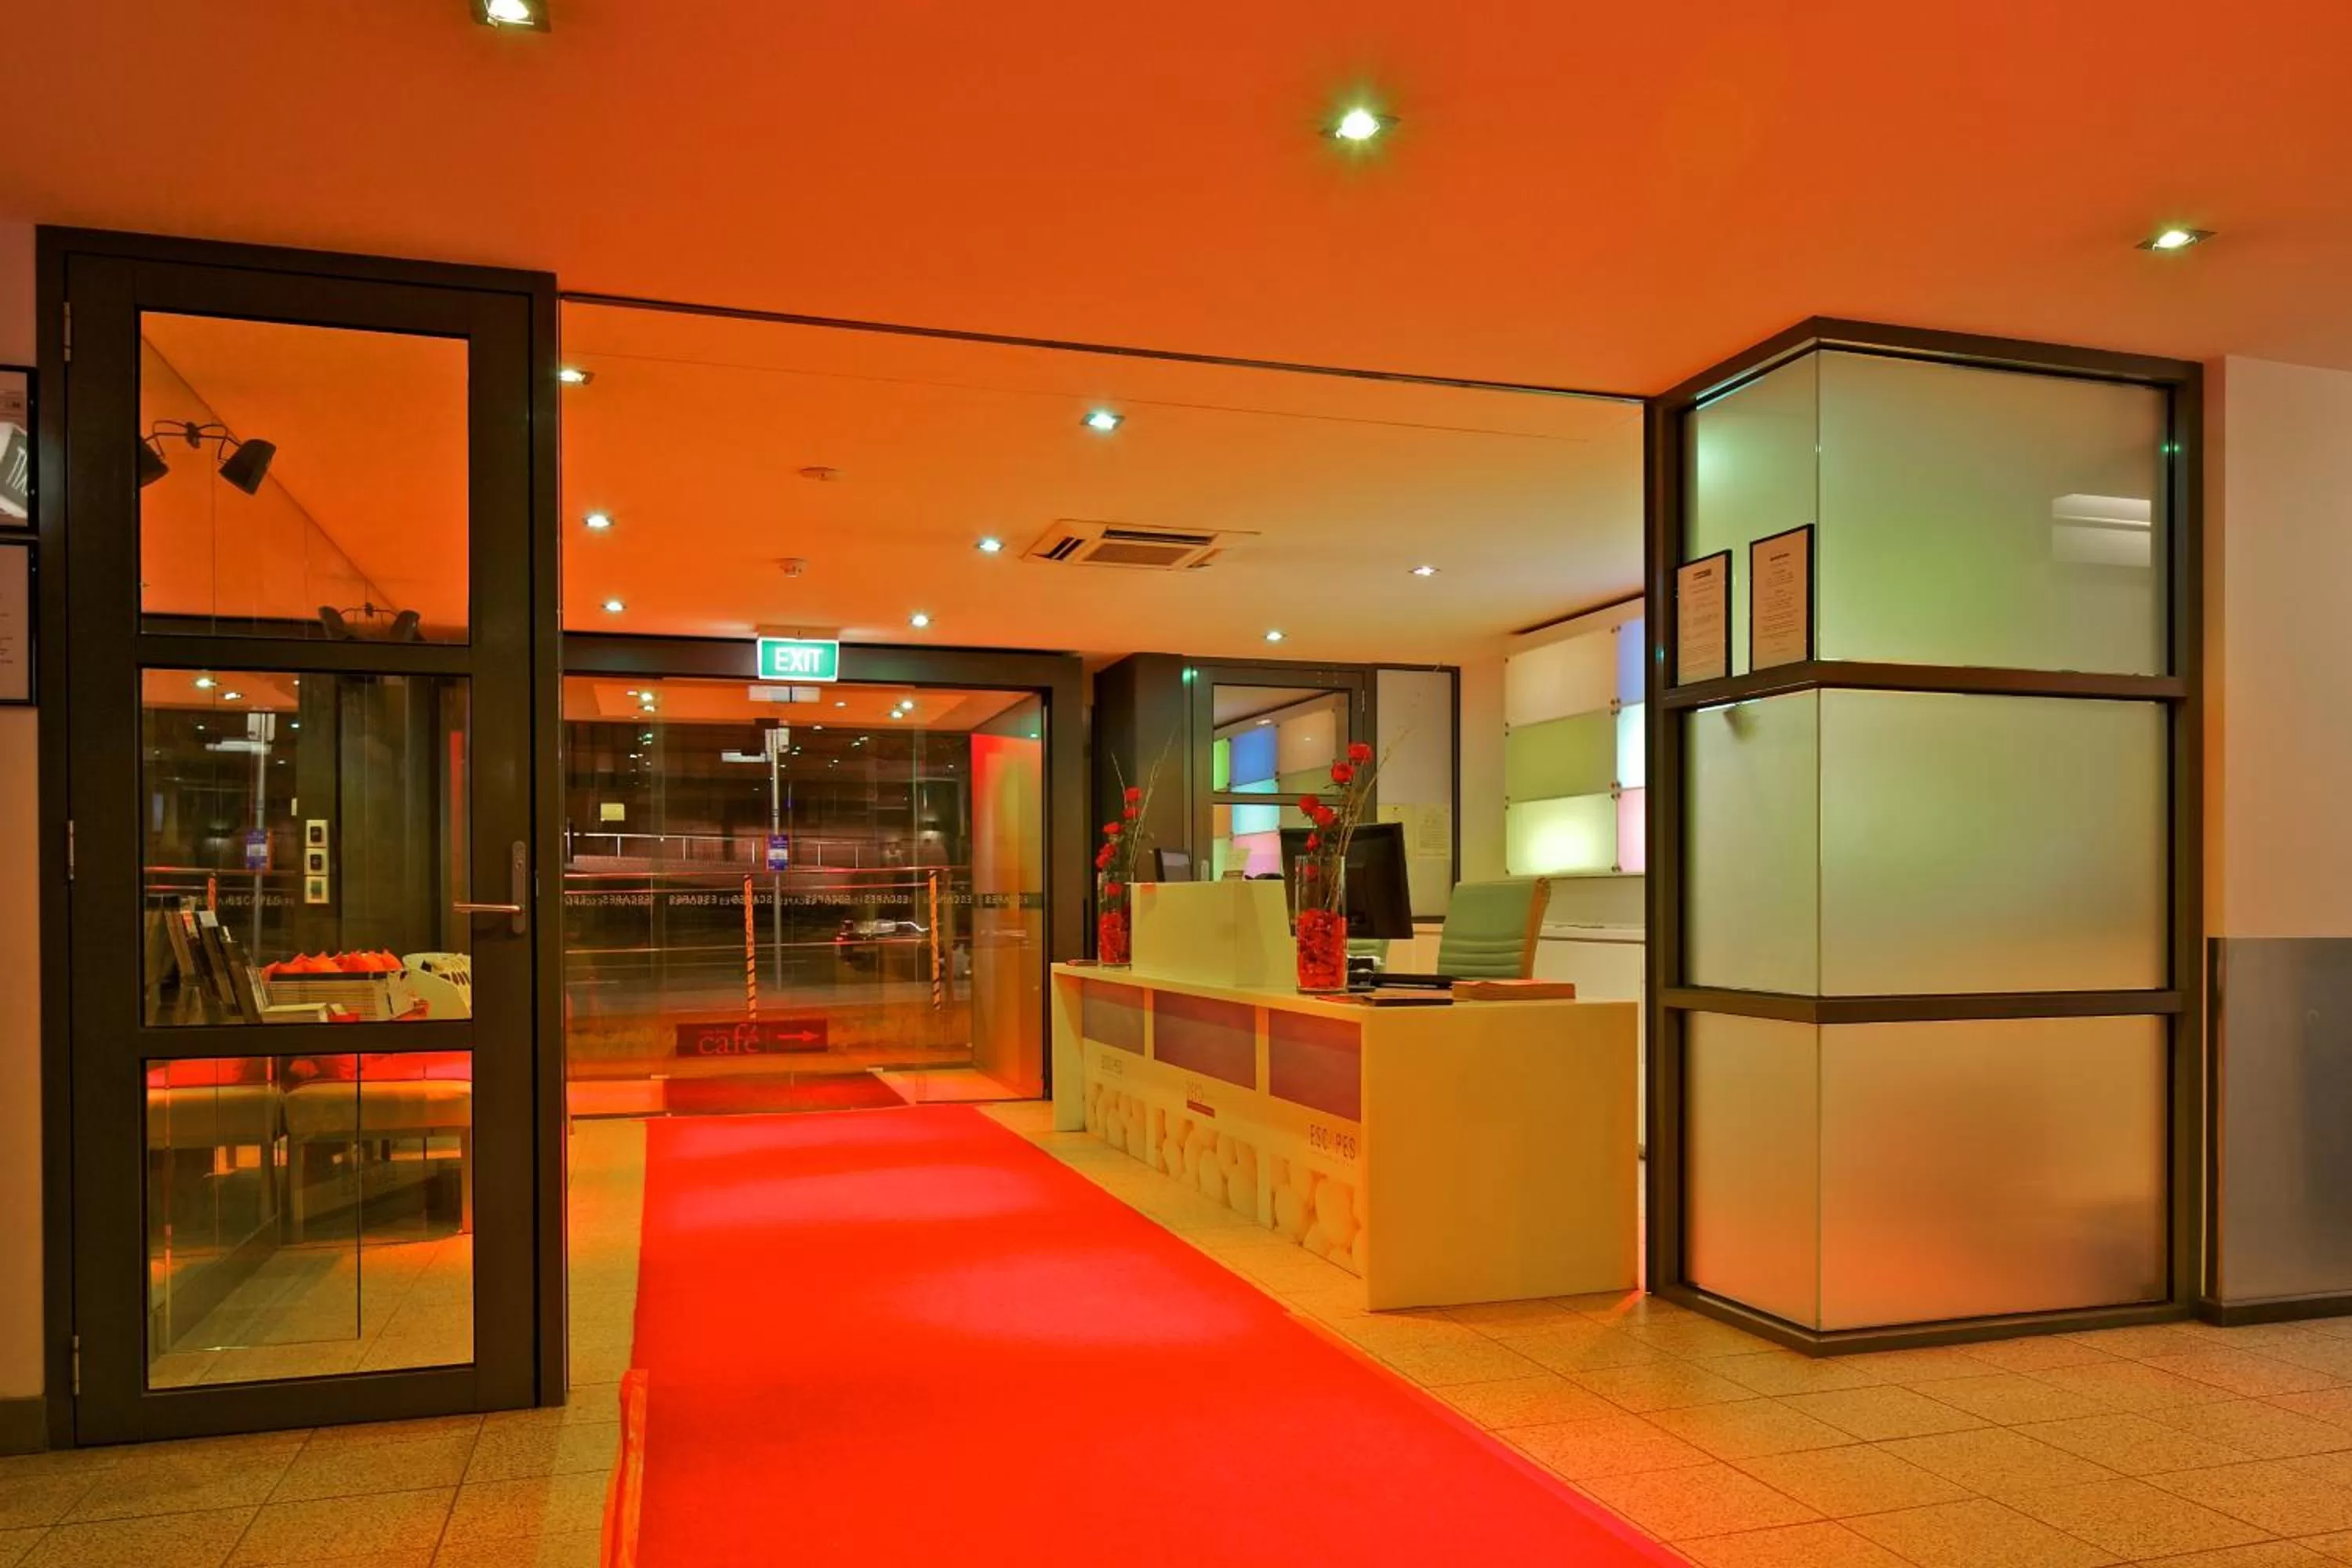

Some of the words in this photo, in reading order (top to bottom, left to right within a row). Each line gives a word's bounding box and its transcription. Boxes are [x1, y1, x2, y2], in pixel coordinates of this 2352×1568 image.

[775, 647, 824, 673] EXIT
[699, 1022, 760, 1054] café
[1310, 1123, 1355, 1160] ESCPES
